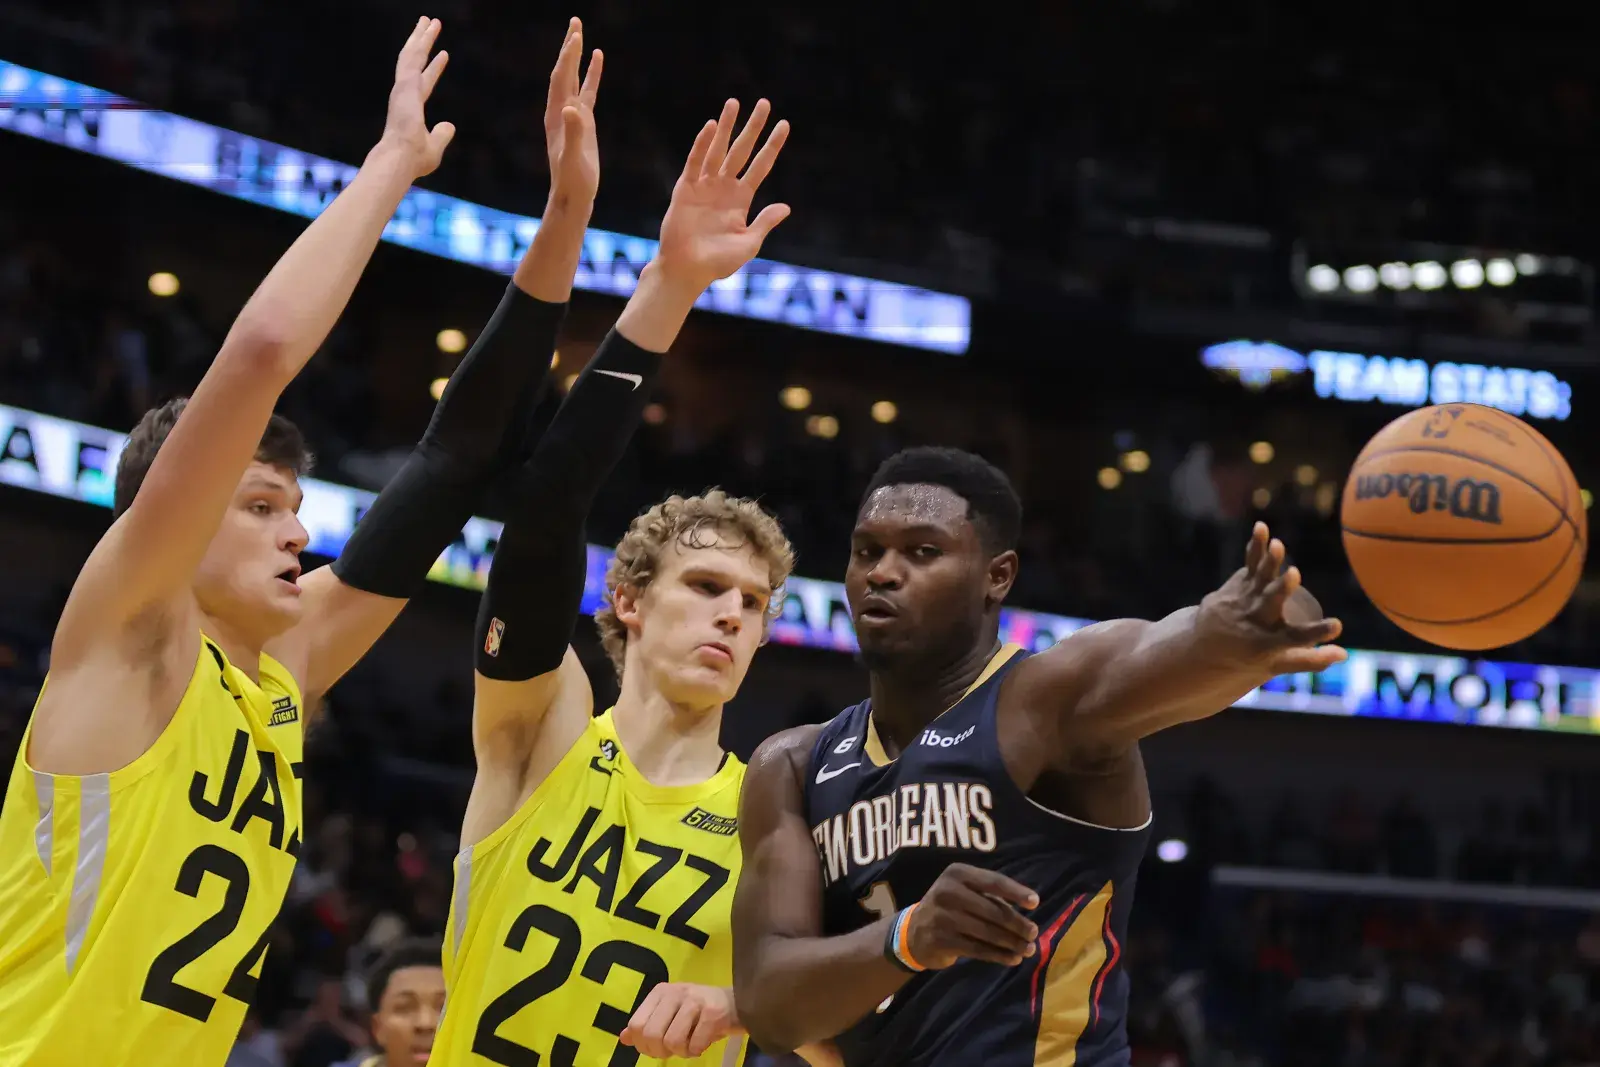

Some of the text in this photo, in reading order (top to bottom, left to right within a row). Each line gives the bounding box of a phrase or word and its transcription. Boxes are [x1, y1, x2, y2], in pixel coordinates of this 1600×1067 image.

[1308, 350, 1428, 405] TEAM
[1354, 473, 1503, 524] Wilson
[274, 709, 296, 723] FIGHT
[833, 736, 858, 754] 6
[920, 725, 976, 747] ibotta
[686, 809, 707, 825] 5
[702, 822, 735, 834] FIGHT
[848, 782, 997, 867] ORLEANS
[526, 806, 731, 950] JAZZ
[471, 904, 669, 1067] 23
